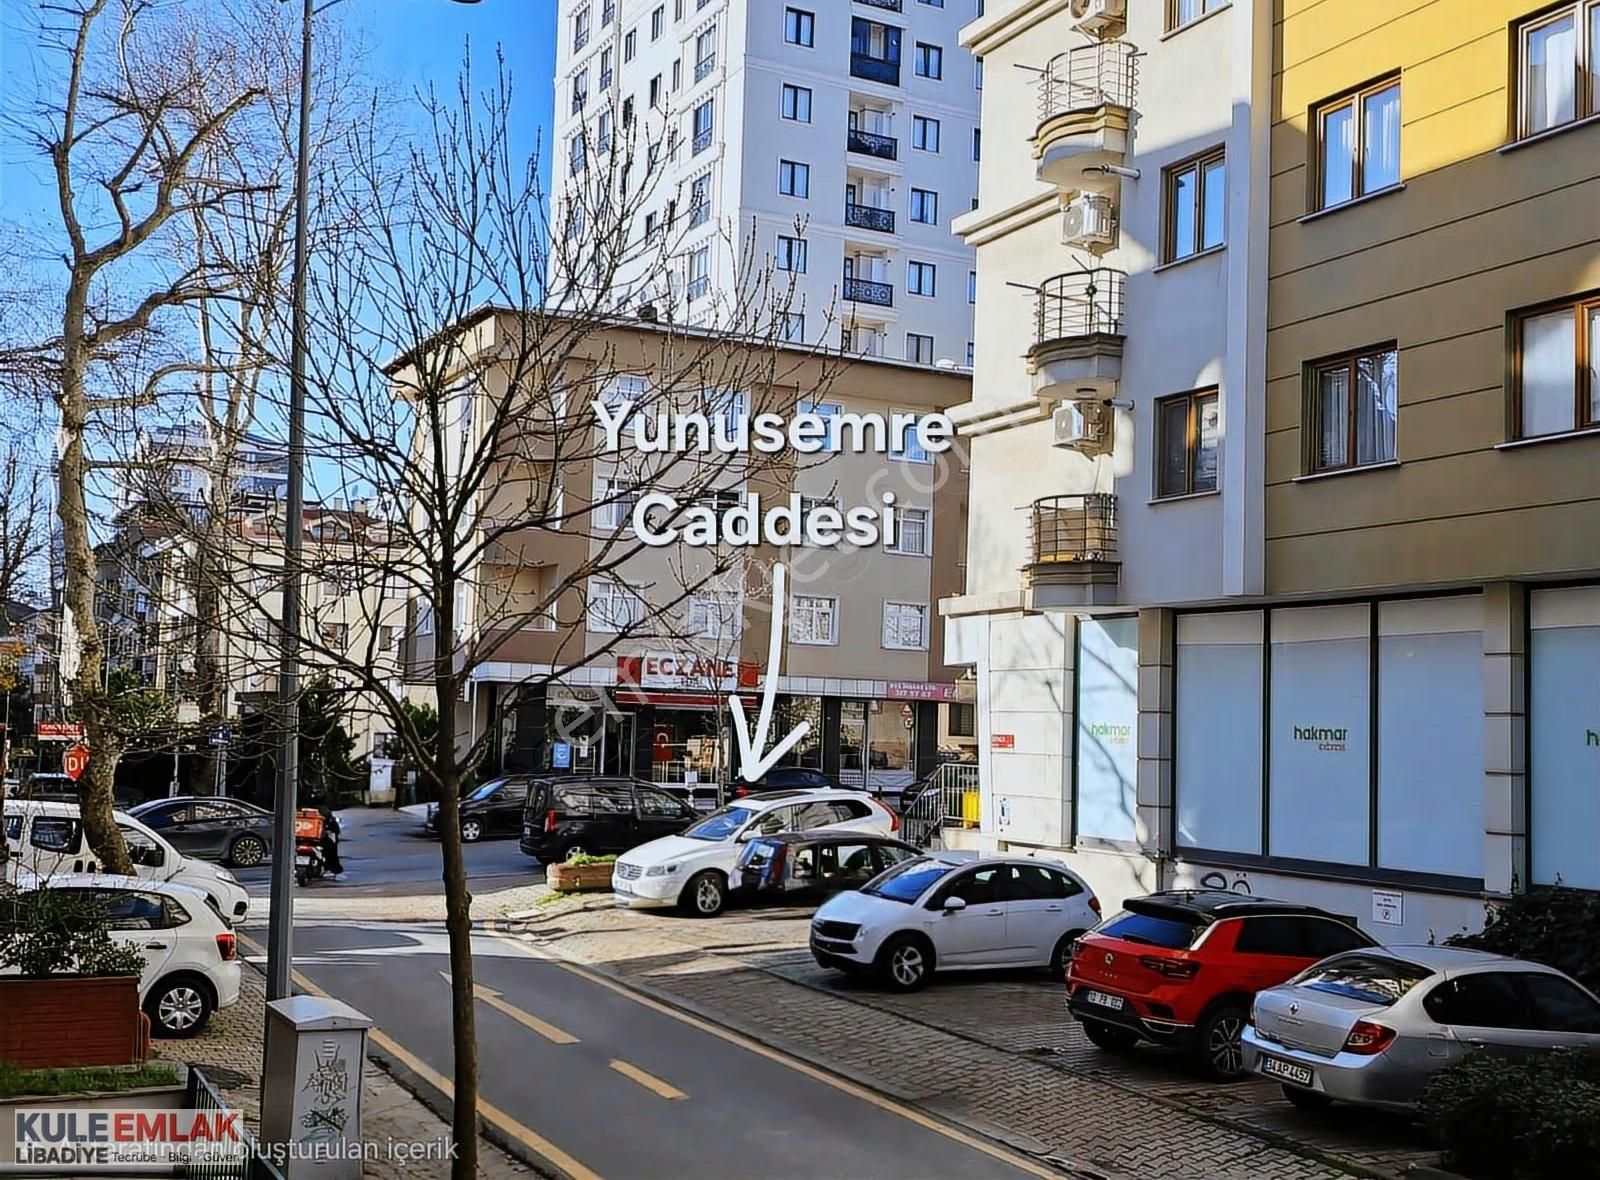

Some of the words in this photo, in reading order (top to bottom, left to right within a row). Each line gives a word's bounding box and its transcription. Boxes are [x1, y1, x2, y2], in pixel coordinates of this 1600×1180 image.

[646, 656, 736, 677] ECZANE
[1091, 722, 1131, 736] hakmar
[1293, 725, 1348, 741] hakmar
